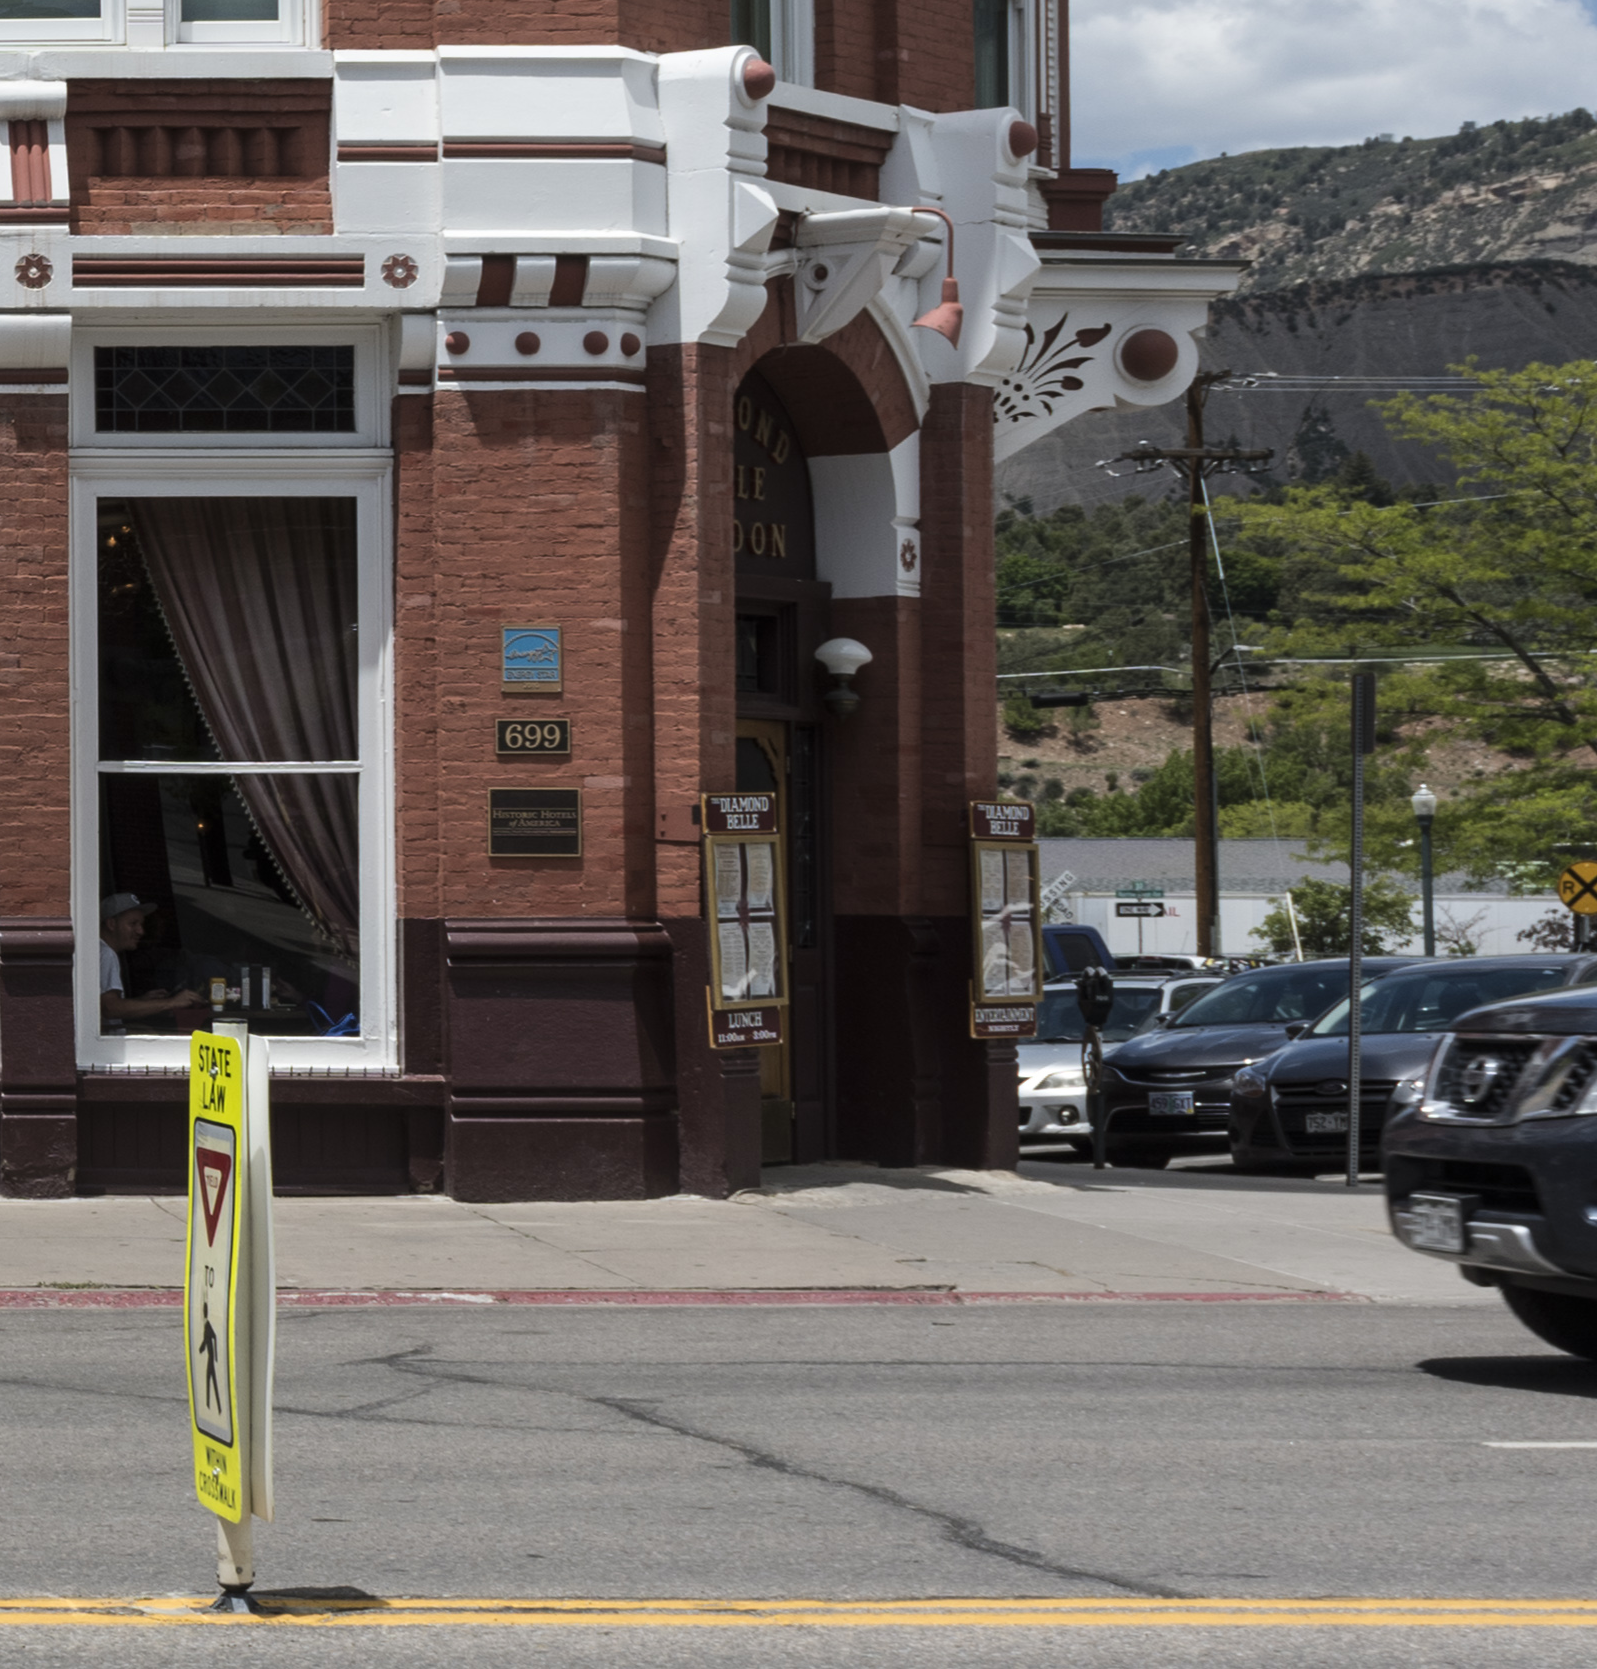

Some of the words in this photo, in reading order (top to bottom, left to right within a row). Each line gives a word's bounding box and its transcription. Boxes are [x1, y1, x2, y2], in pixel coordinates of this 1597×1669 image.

[505, 724, 561, 749] 699
[720, 796, 769, 813] DIAMOND
[985, 805, 1030, 820] DIAMOND
[726, 814, 760, 830] BELLE
[990, 820, 1020, 836] BELLE
[1041, 873, 1074, 907] SSING
[728, 1011, 763, 1029] LUNCH
[198, 1044, 231, 1078] STATE
[203, 1080, 226, 1113] LAW
[204, 1265, 215, 1289] TO
